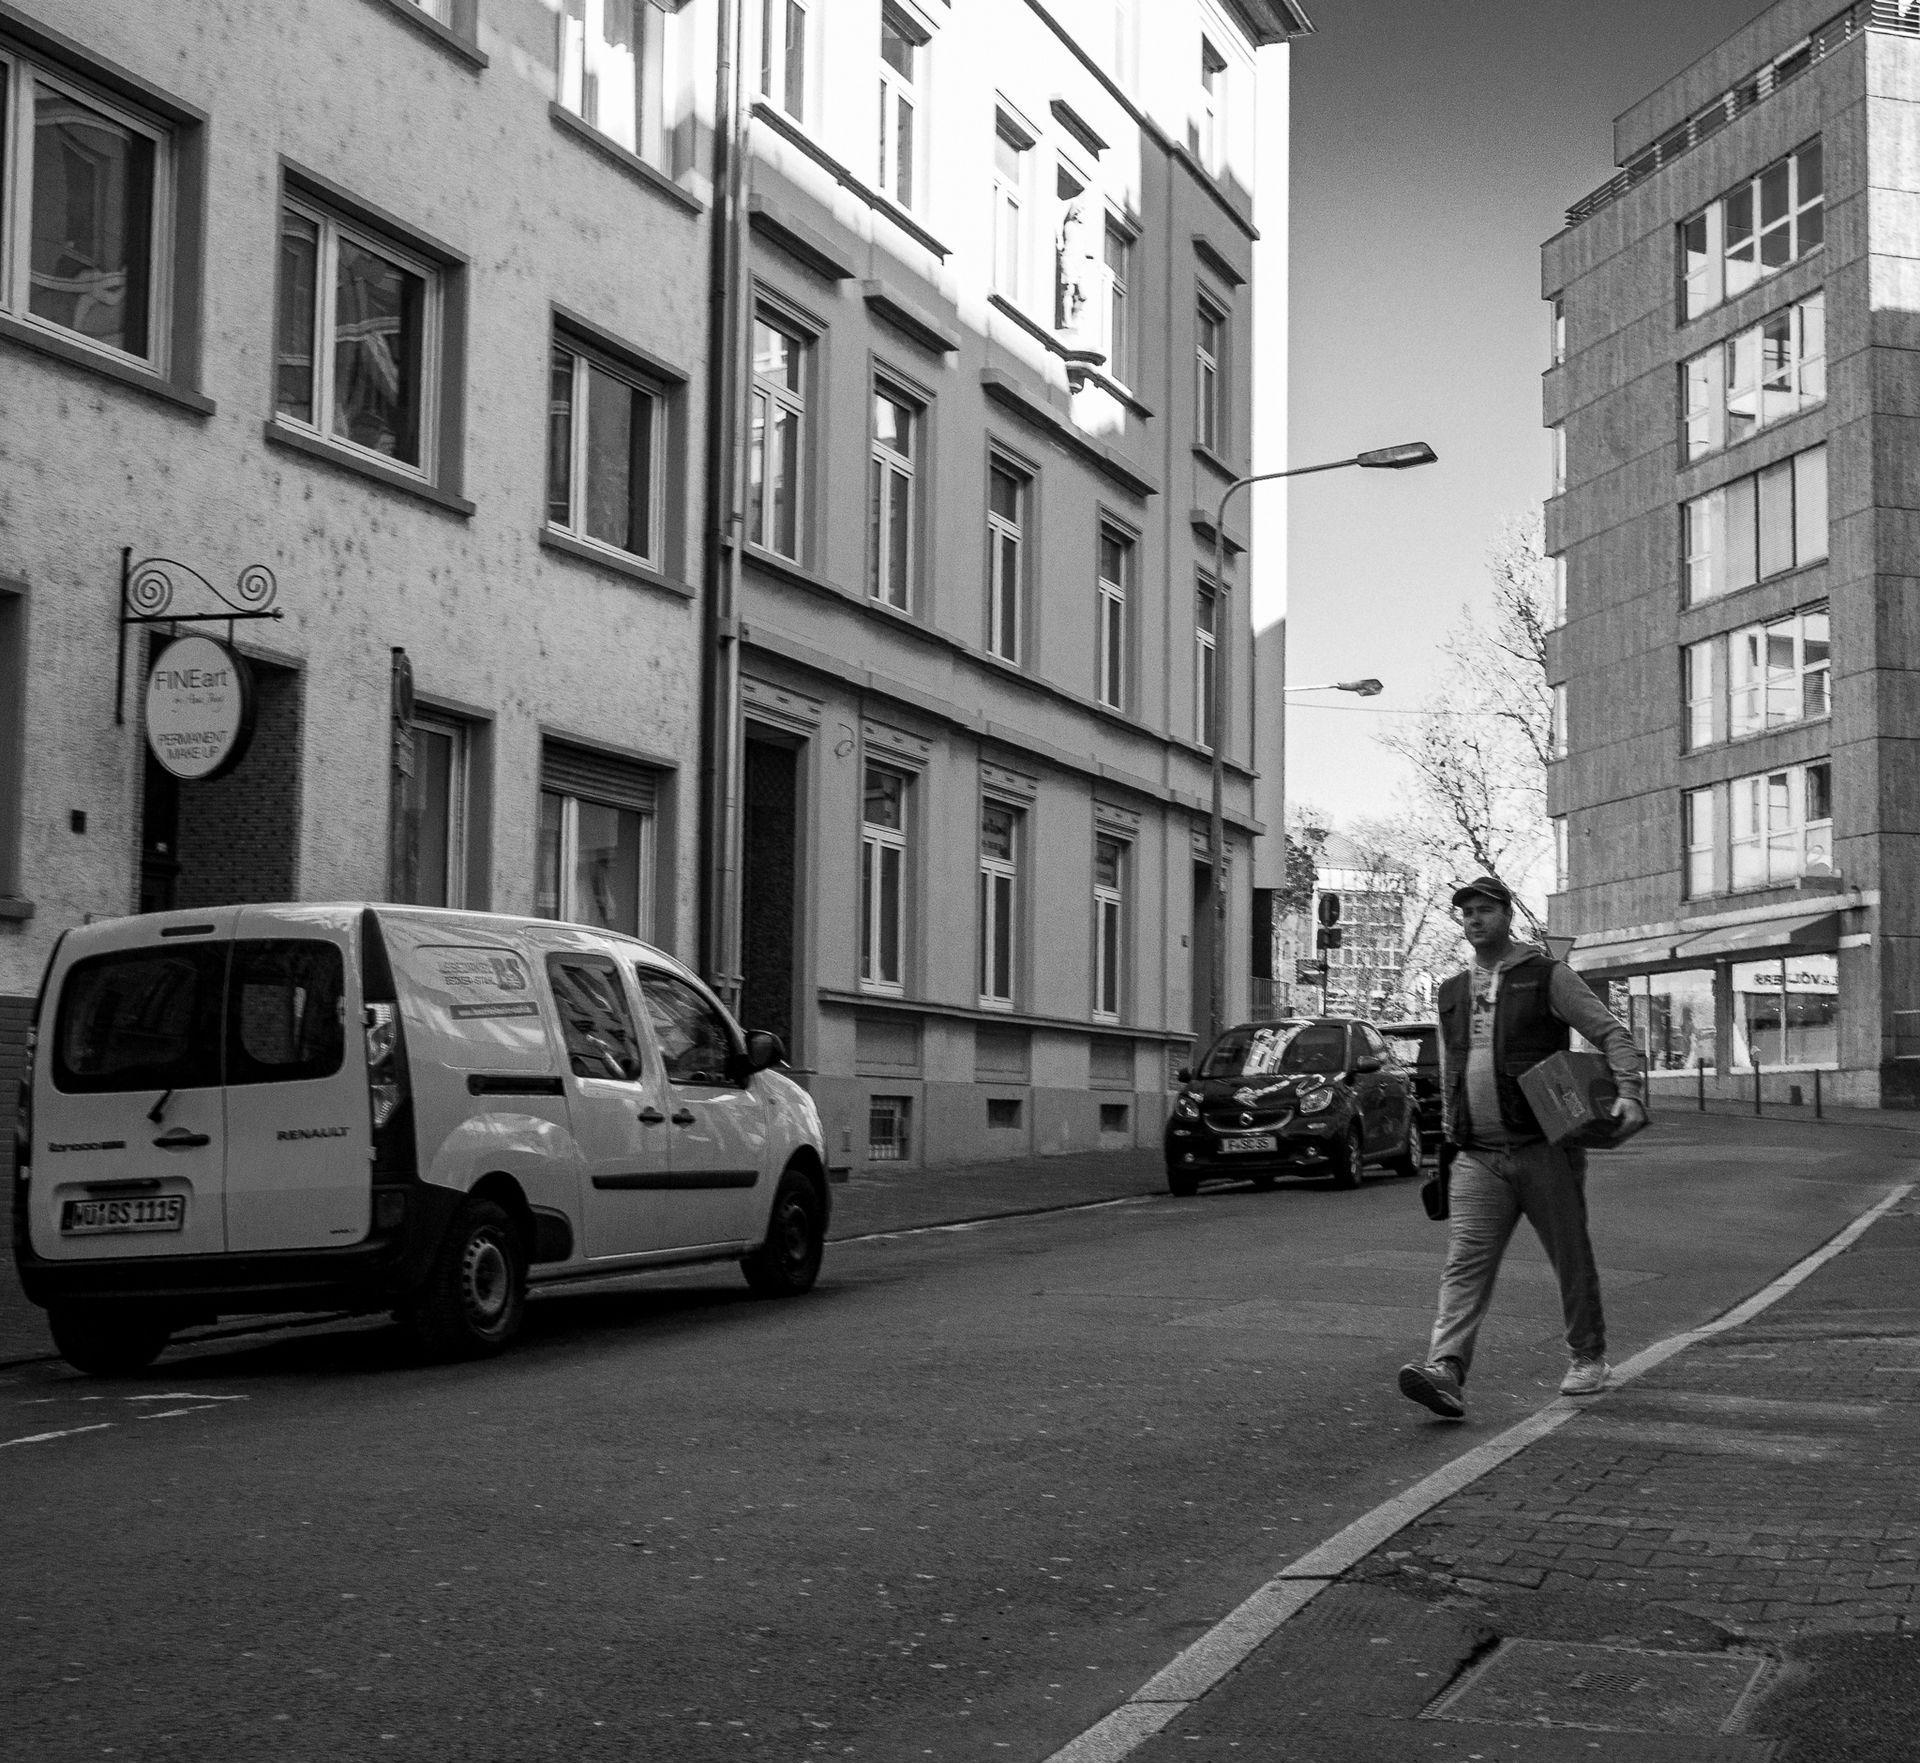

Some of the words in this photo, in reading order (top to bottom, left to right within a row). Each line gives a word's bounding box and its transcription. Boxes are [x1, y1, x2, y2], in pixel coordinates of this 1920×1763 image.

[154, 669, 227, 691] FINEart
[157, 730, 228, 746] PERMANENT
[276, 1126, 350, 1141] RENAULT
[134, 1200, 177, 1223] 1115
